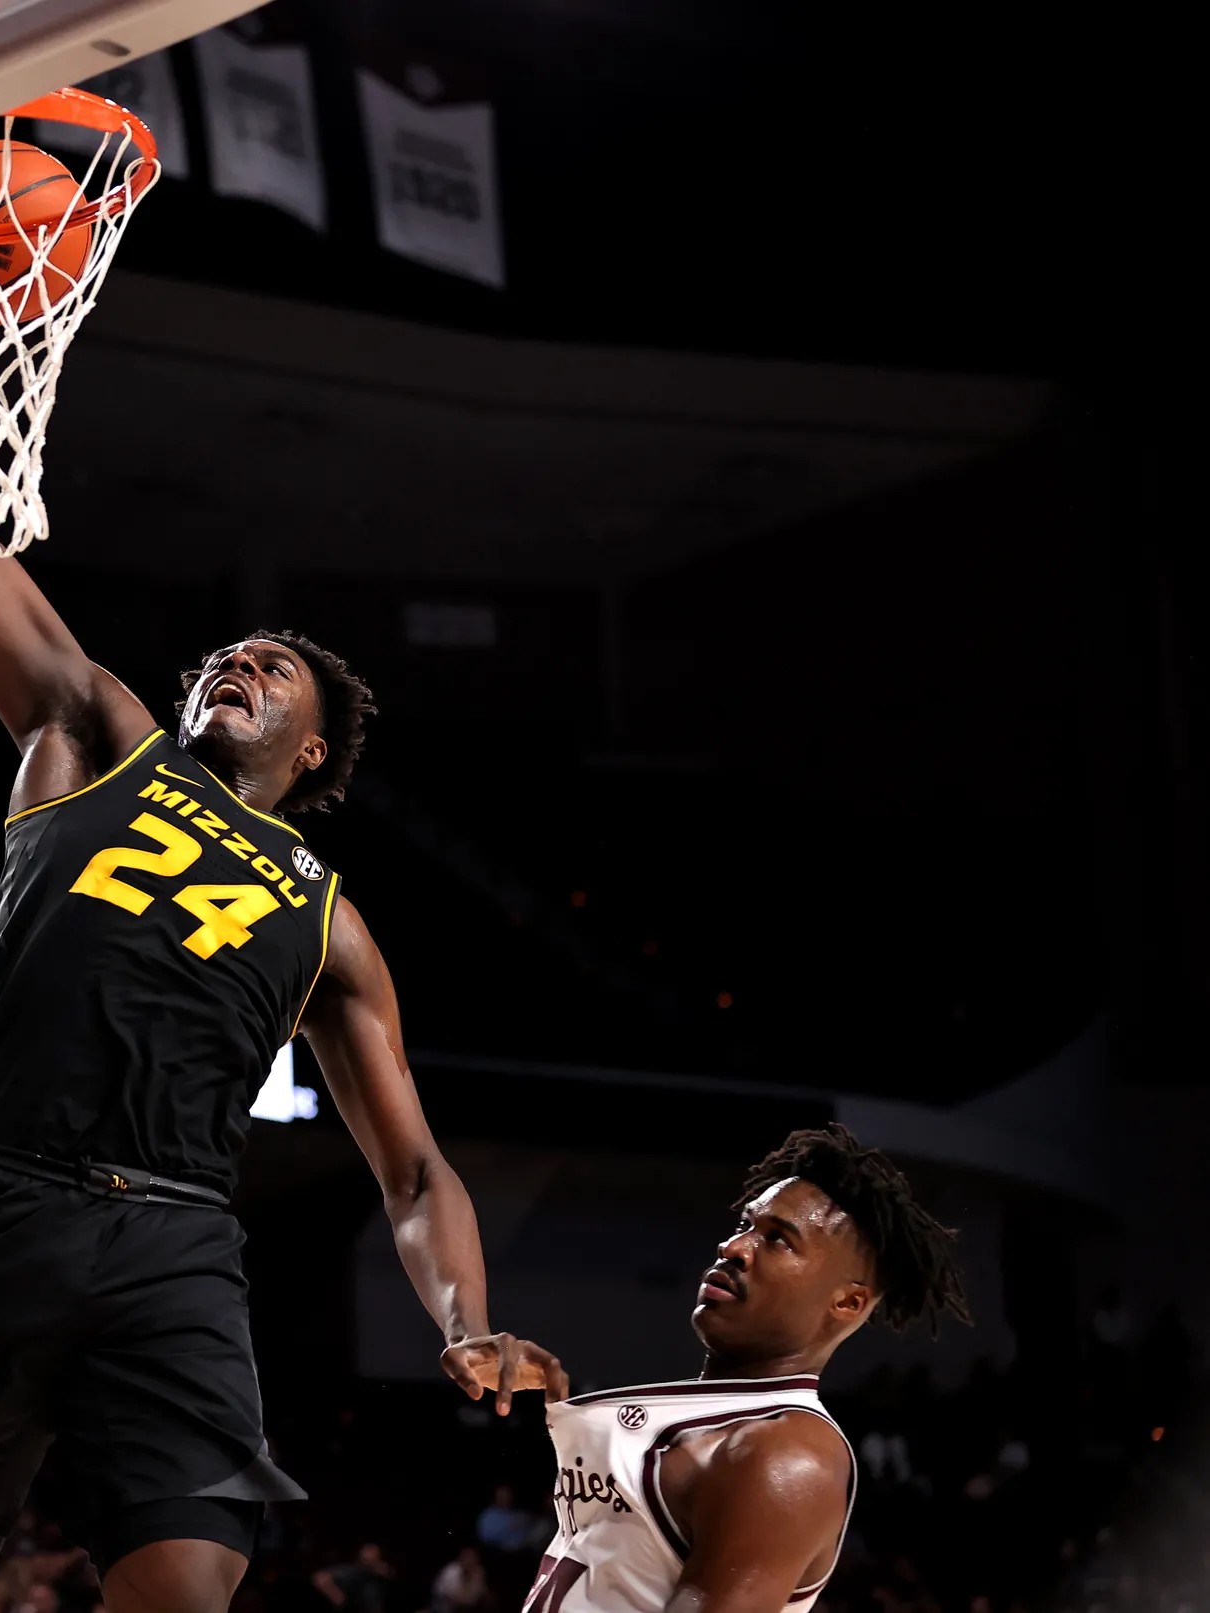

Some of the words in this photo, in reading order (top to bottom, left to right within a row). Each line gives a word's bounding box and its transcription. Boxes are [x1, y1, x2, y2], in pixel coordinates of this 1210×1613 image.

[137, 779, 309, 908] MIZZOU
[293, 848, 323, 879] SEC
[68, 812, 282, 961] 24
[620, 1404, 646, 1428] SEC
[553, 1456, 633, 1537] gies
